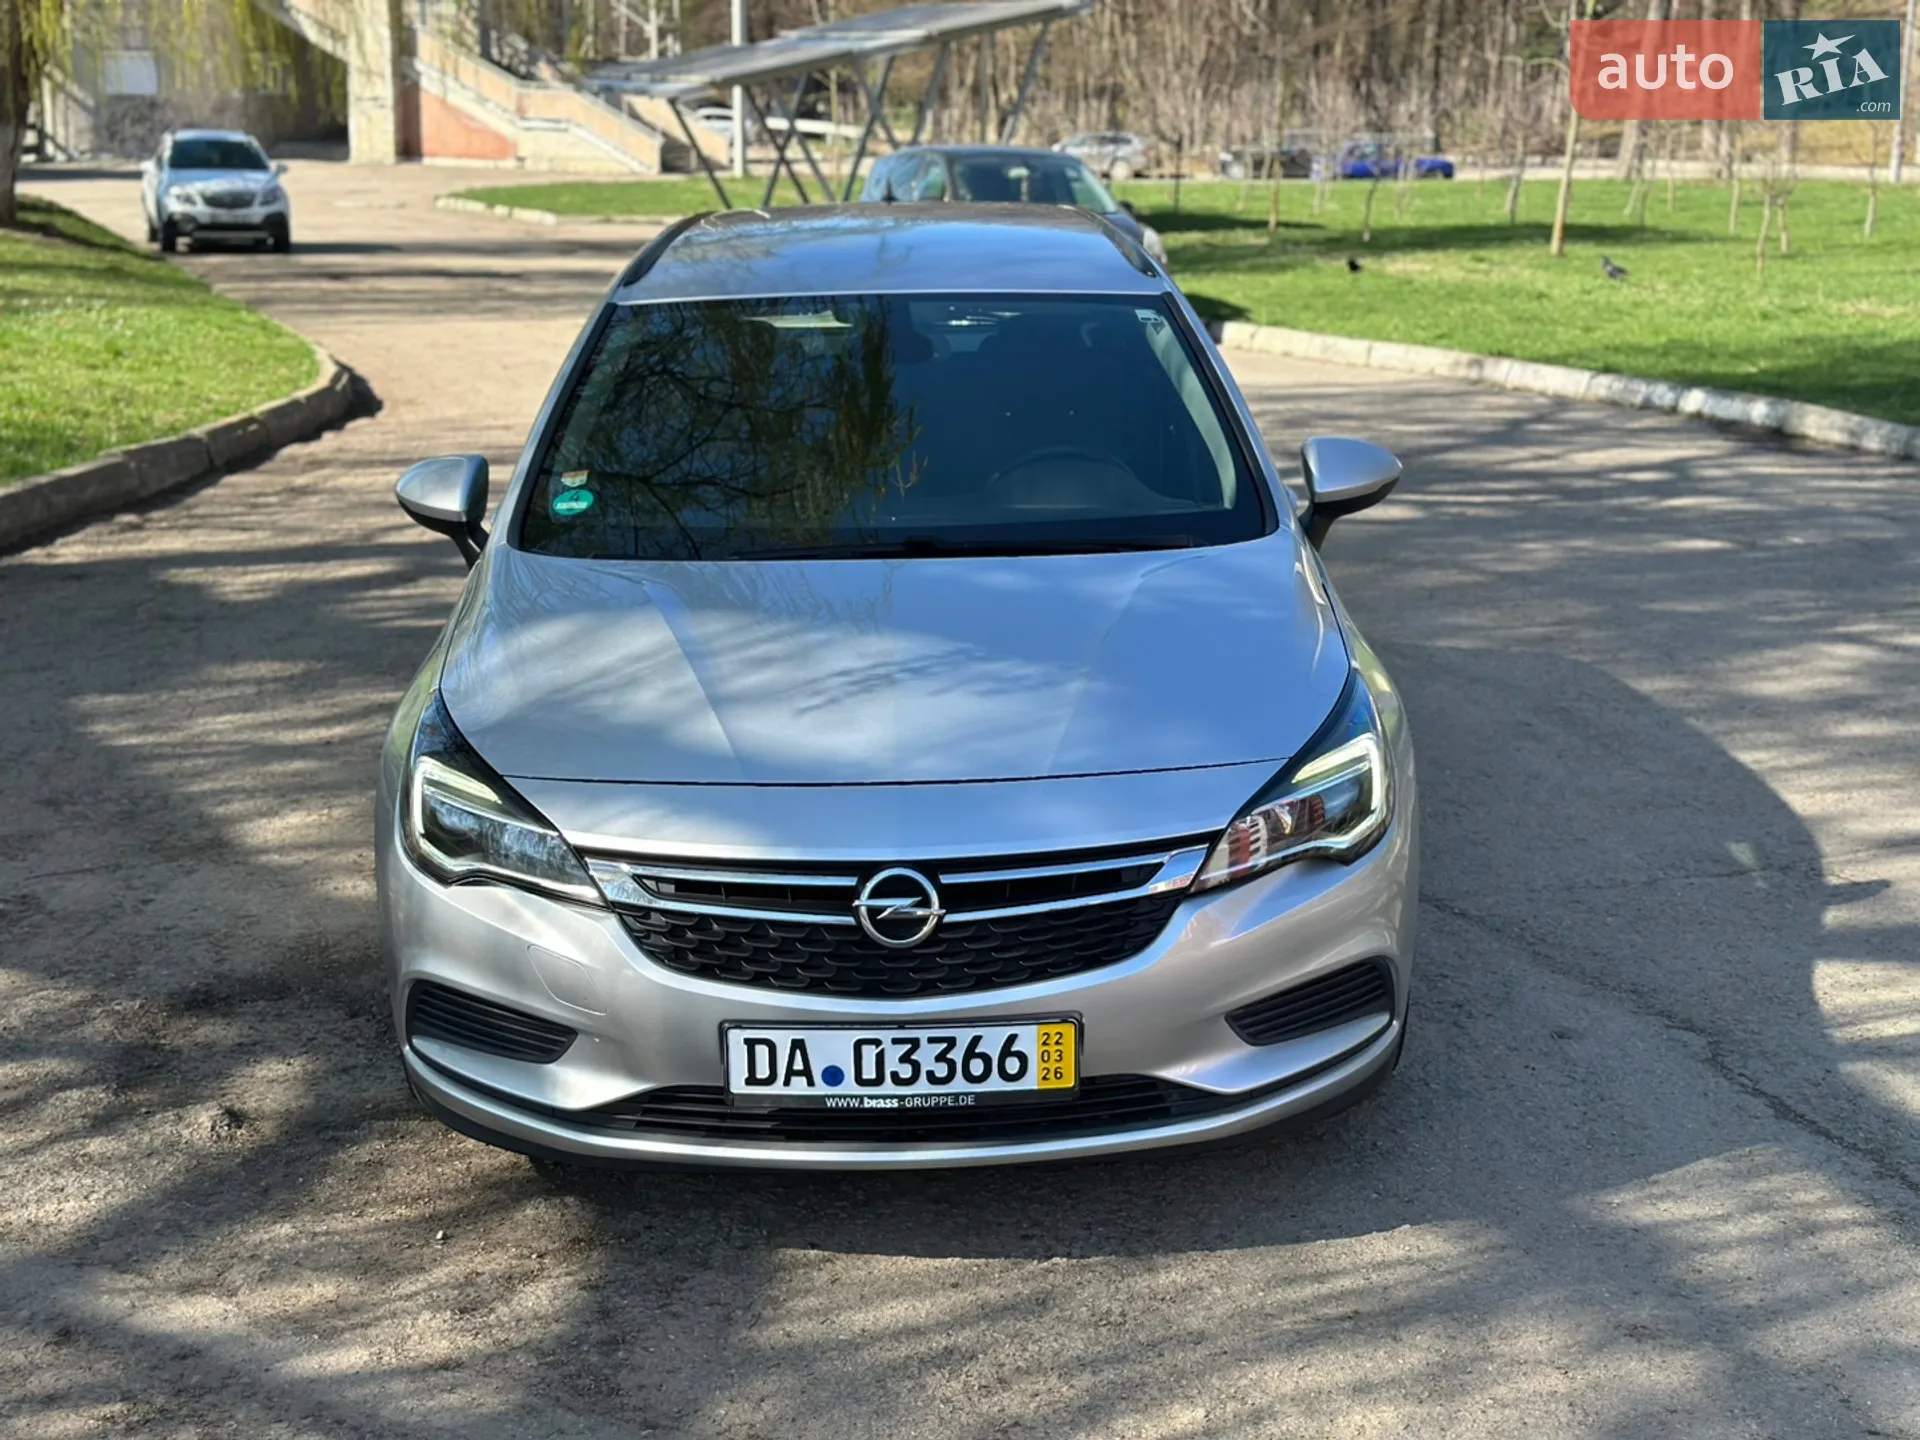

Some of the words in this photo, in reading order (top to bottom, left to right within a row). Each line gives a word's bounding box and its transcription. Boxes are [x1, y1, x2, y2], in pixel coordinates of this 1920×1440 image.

[1041, 1031, 1063, 1046] 22
[742, 1037, 816, 1087] DA
[854, 1032, 1030, 1087] 03366
[1041, 1049, 1063, 1063] 03
[1041, 1066, 1063, 1081] 26
